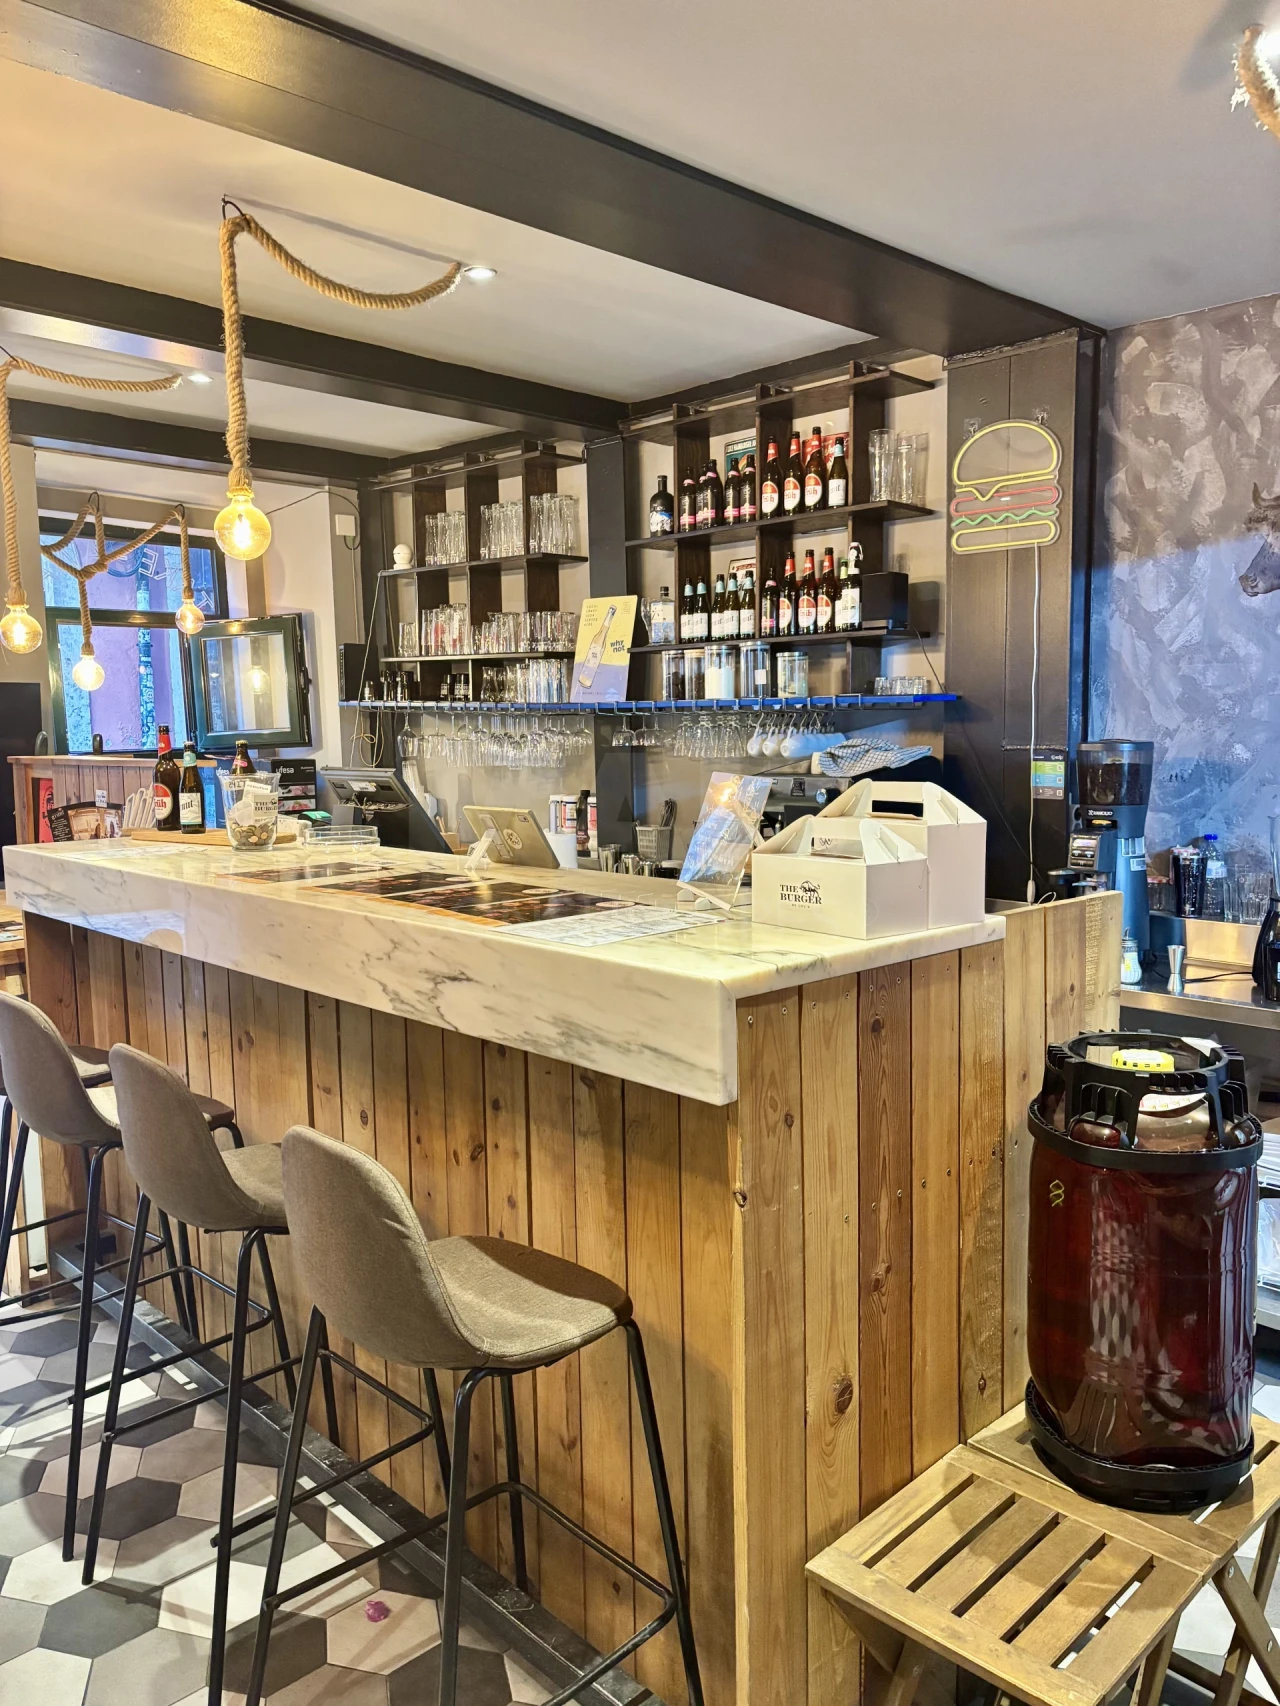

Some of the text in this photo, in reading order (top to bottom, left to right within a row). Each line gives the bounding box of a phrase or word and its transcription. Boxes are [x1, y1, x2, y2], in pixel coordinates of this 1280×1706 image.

[610, 639, 625, 648] why
[612, 645, 626, 653] not
[275, 765, 295, 774] ufesa
[780, 884, 798, 893] THE
[780, 892, 822, 905] BURGER
